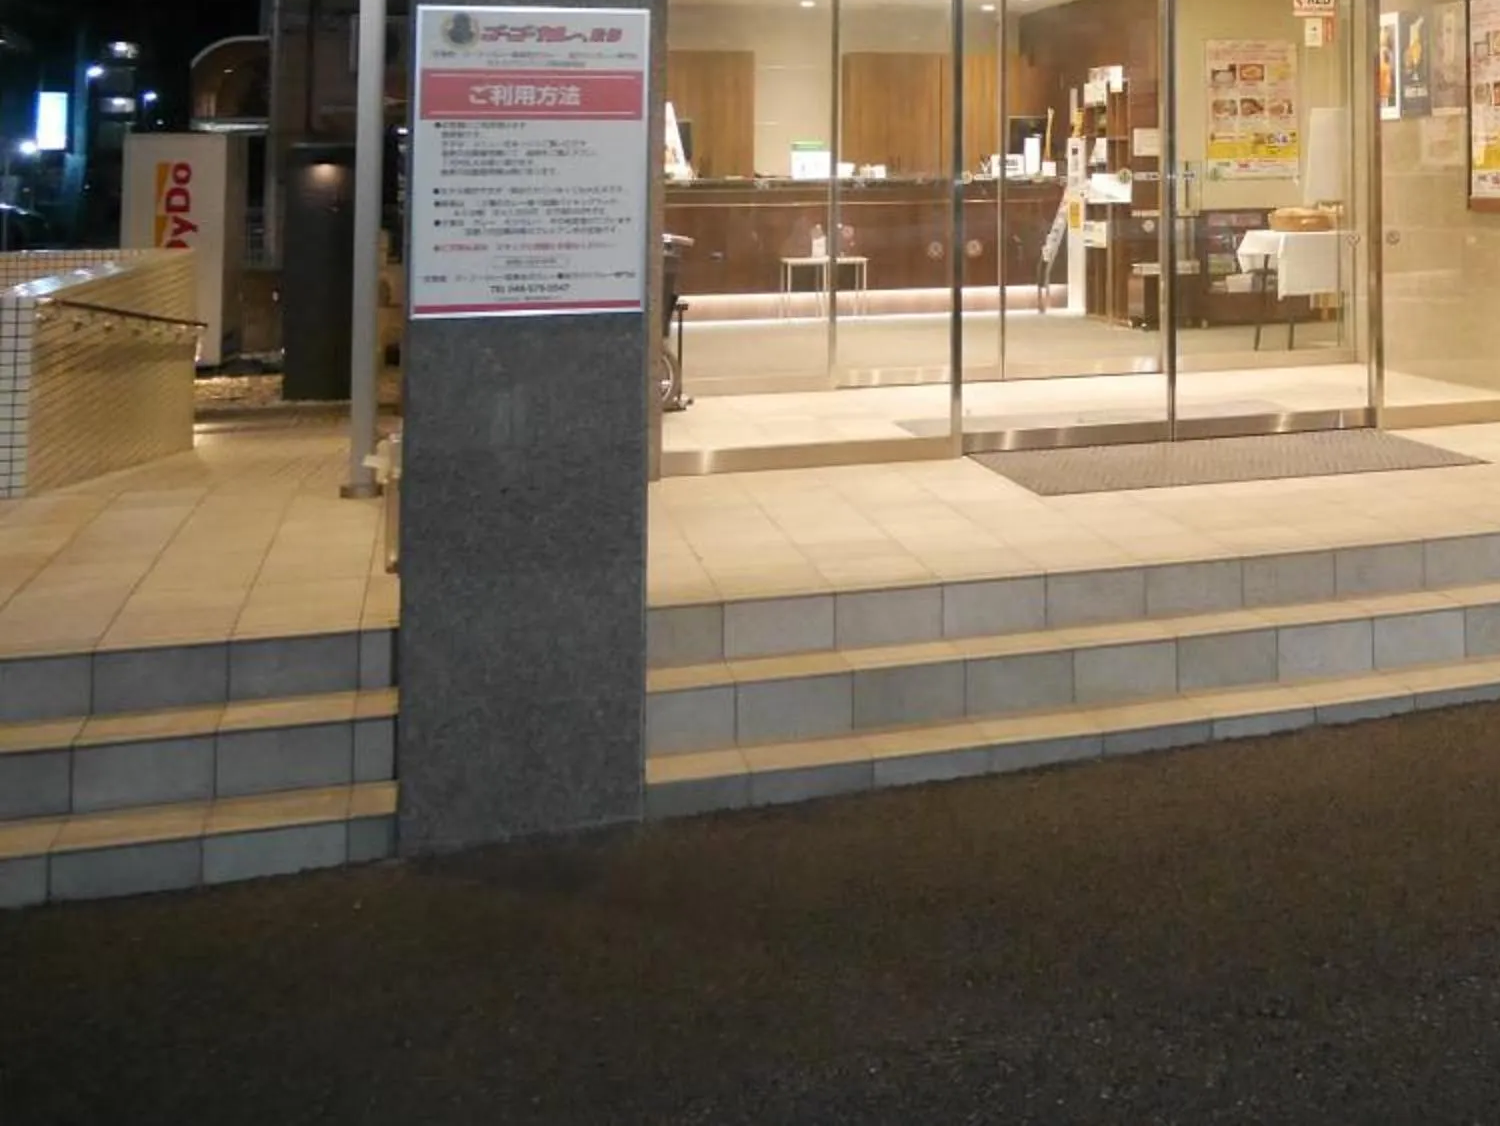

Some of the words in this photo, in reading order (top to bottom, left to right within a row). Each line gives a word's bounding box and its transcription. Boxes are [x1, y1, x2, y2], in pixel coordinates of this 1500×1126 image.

[468, 84, 581, 107] ご利用方法
